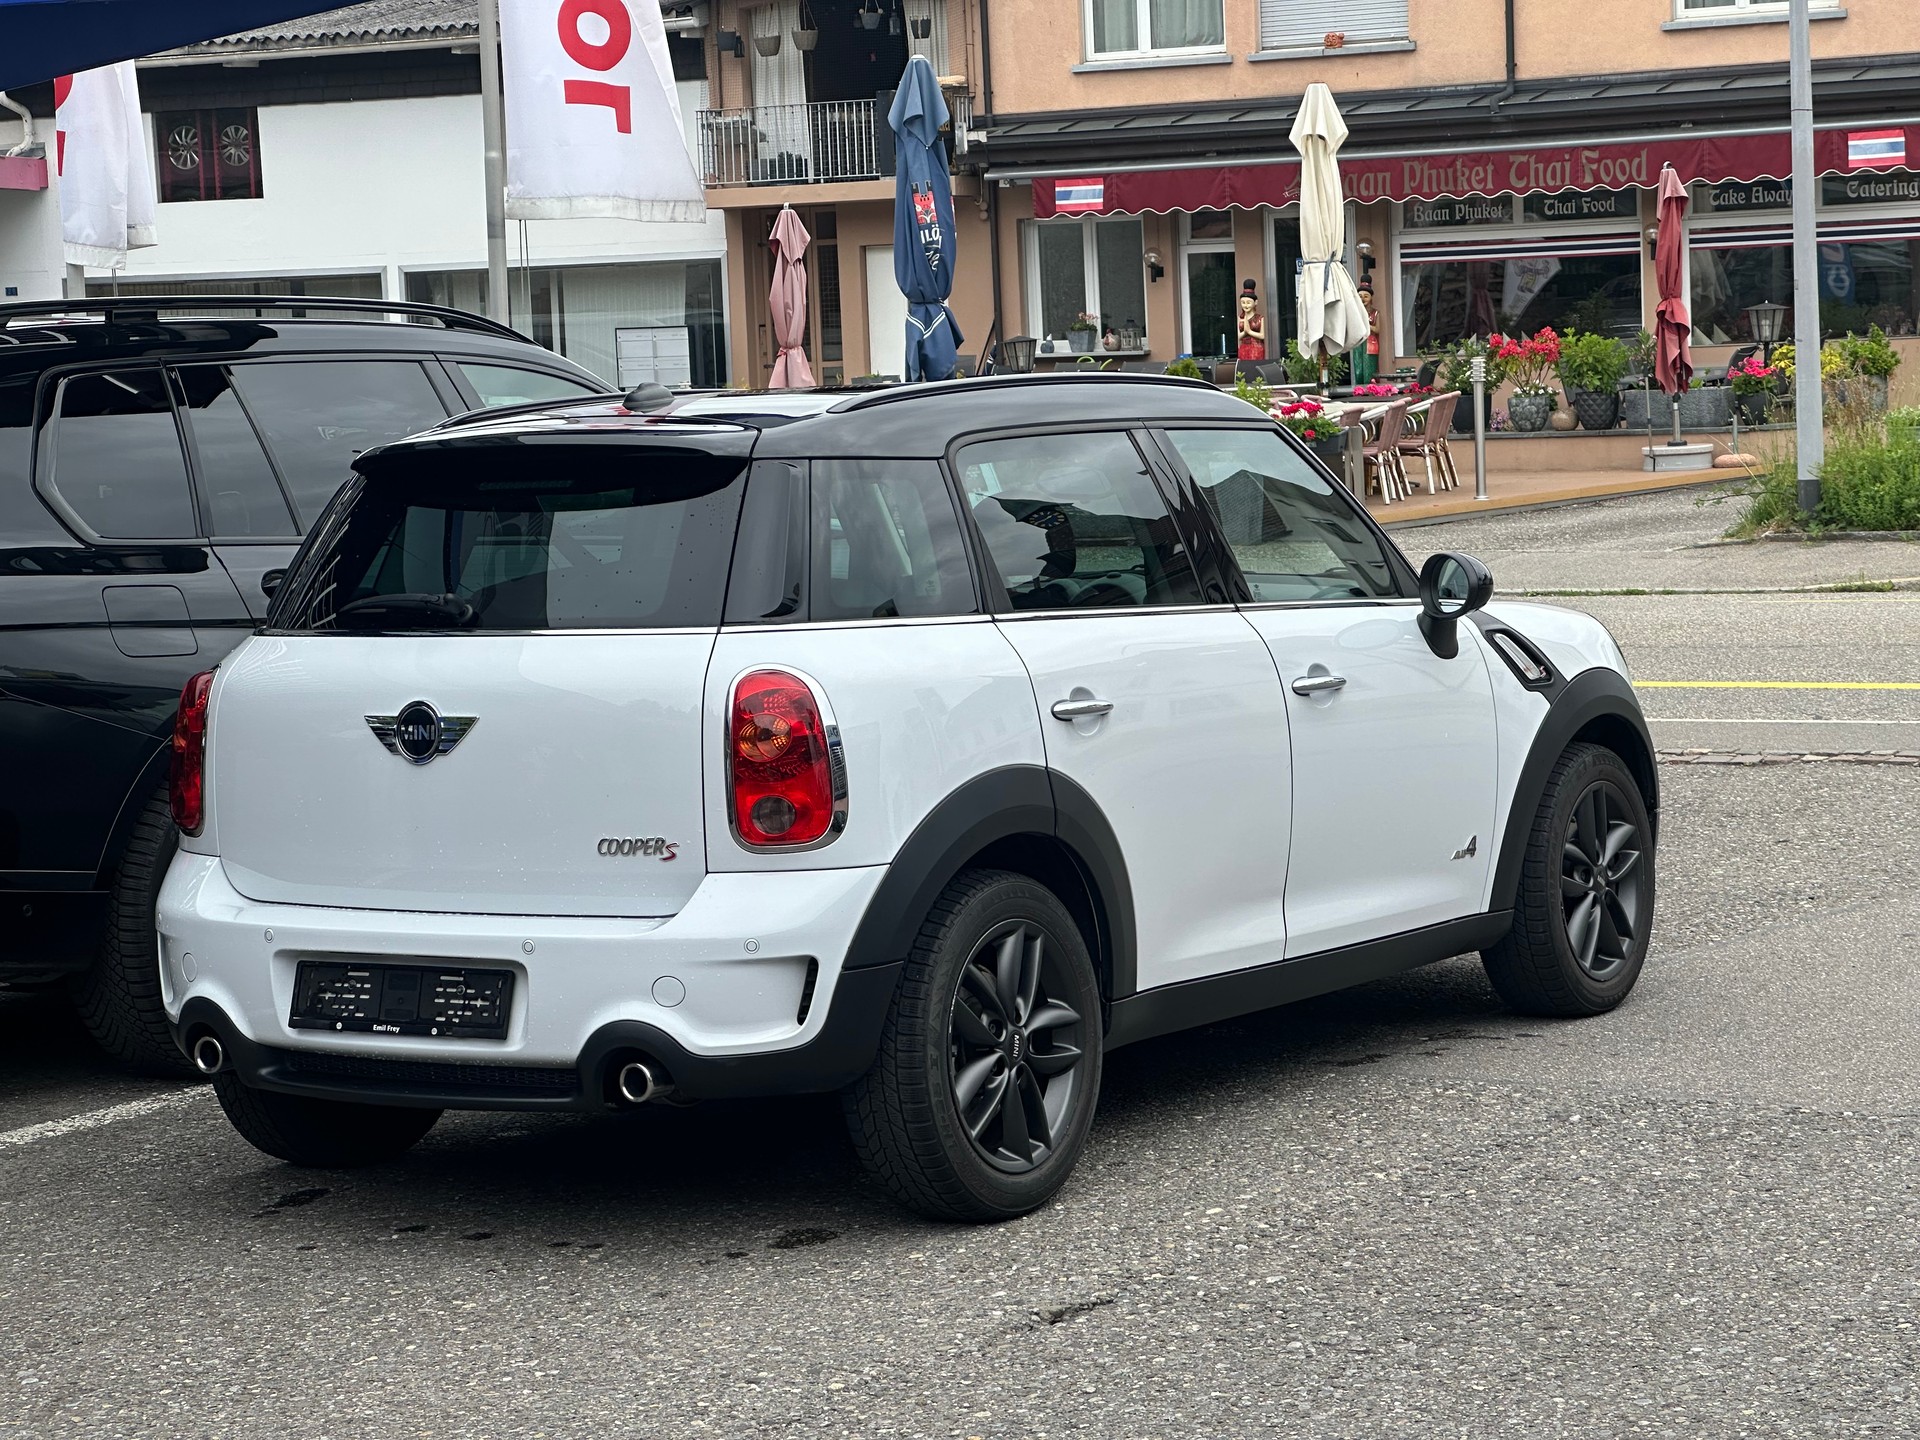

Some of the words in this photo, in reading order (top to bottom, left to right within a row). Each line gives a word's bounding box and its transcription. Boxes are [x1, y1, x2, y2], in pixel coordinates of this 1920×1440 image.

[1344, 171, 1391, 196] aan
[1403, 157, 1495, 194] Phuket
[1508, 153, 1571, 188] Thai
[1581, 148, 1648, 183] Food
[1709, 188, 1746, 206] Take
[1751, 186, 1794, 204] Away
[1846, 178, 1919, 198] Catering
[1413, 205, 1450, 222] Baan
[1455, 202, 1503, 220] Phuket
[1544, 199, 1576, 215] Thai
[1582, 196, 1615, 213] Food
[400, 724, 435, 741] MINI
[387, 1025, 400, 1034] Frey
